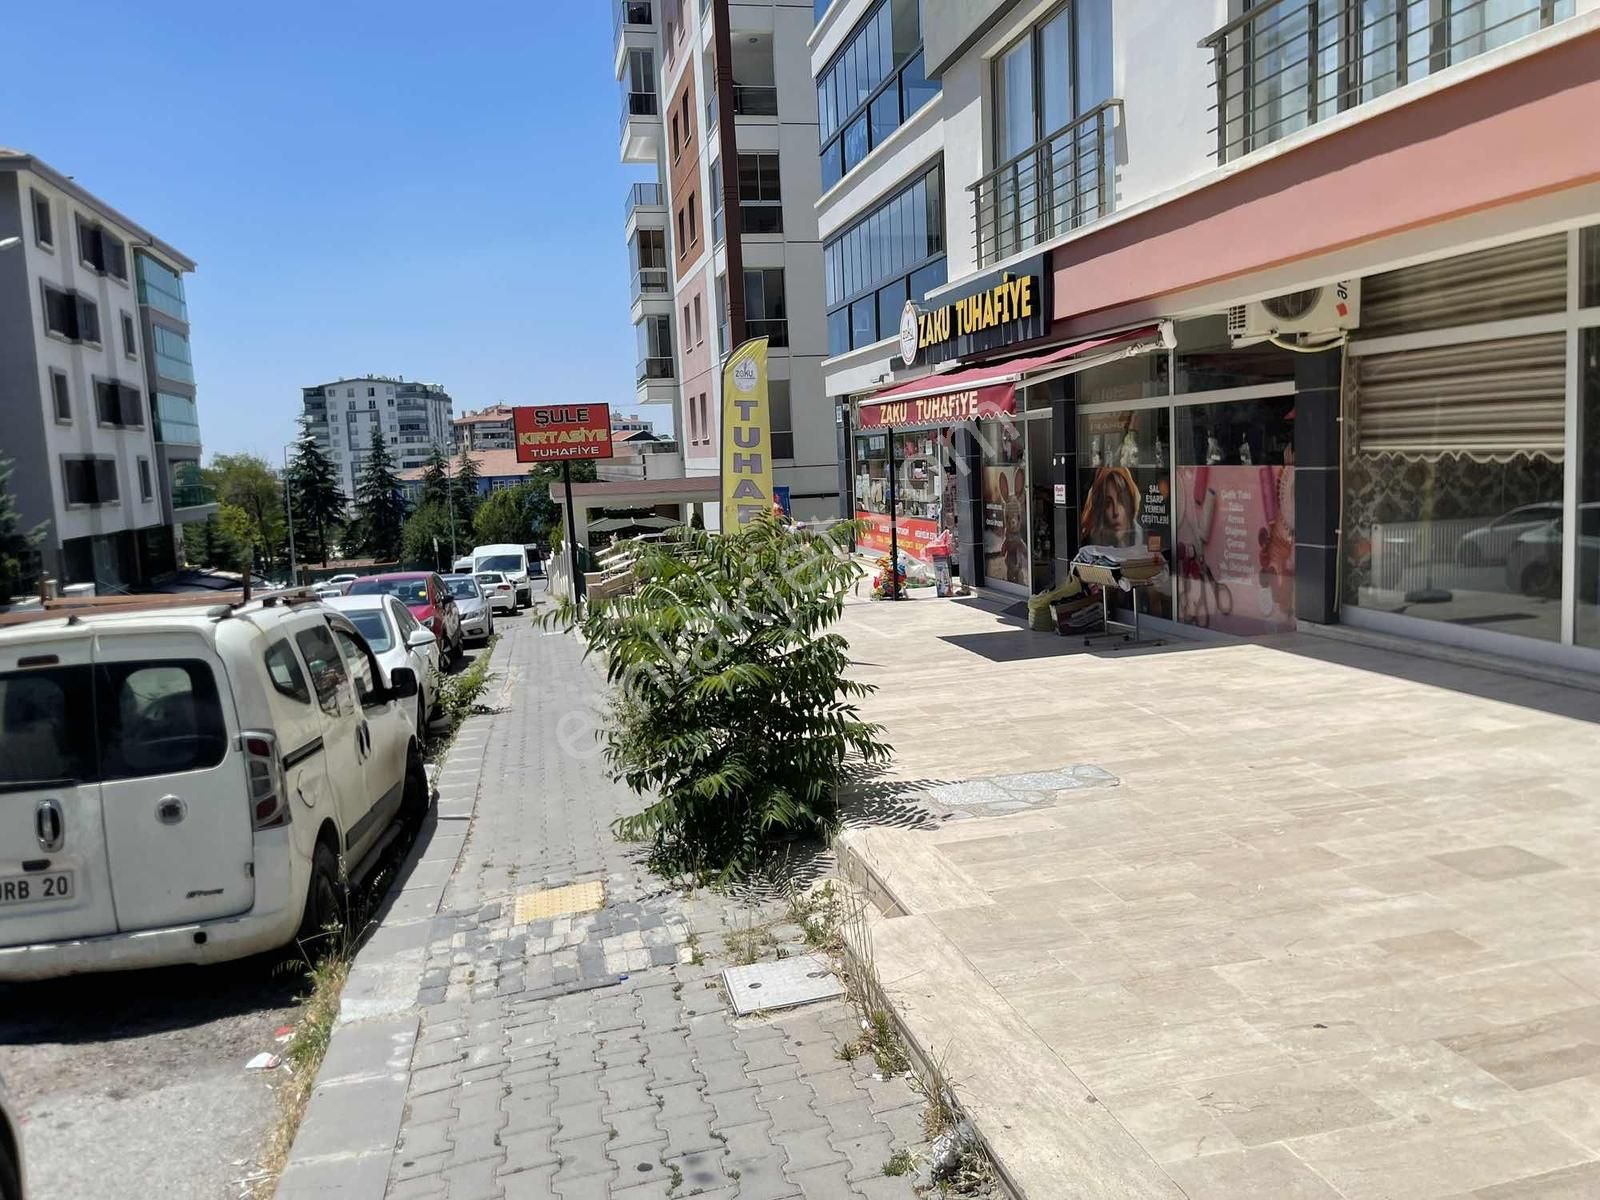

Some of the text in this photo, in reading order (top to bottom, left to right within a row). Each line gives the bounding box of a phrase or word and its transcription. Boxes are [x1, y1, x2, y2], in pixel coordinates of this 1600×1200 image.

[918, 272, 1032, 348] ZAKU TUHAFİYE
[534, 408, 590, 428] ŞULE
[880, 391, 979, 424] ZAKU TUHAFİYE
[519, 427, 608, 446] KIRTASİYE
[531, 446, 600, 457] TUHAFİYE
[0, 876, 68, 901] RB 20
